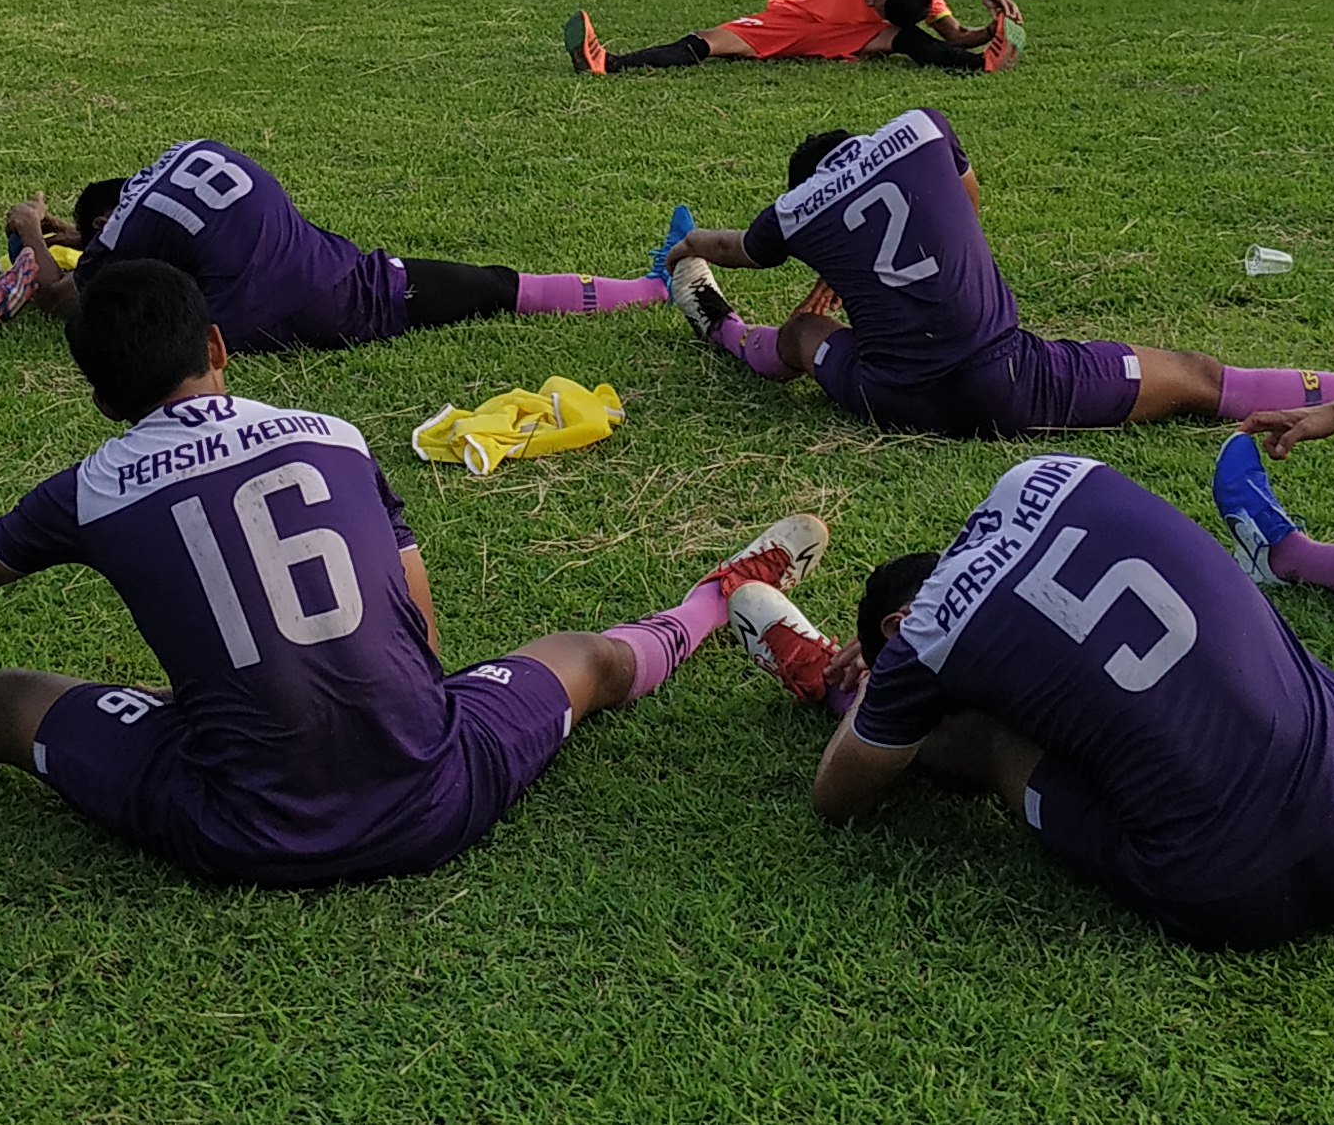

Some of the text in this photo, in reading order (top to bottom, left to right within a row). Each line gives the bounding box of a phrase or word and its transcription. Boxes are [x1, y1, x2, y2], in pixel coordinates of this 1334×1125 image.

[142, 149, 254, 237] 18
[859, 123, 919, 178] KEDIRI
[843, 181, 940, 288] 2
[117, 415, 332, 497] PERSIK KEDIRI
[170, 461, 364, 670] 16
[934, 460, 1084, 637] PERSIK KEDIRI
[1013, 526, 1198, 693] 5
